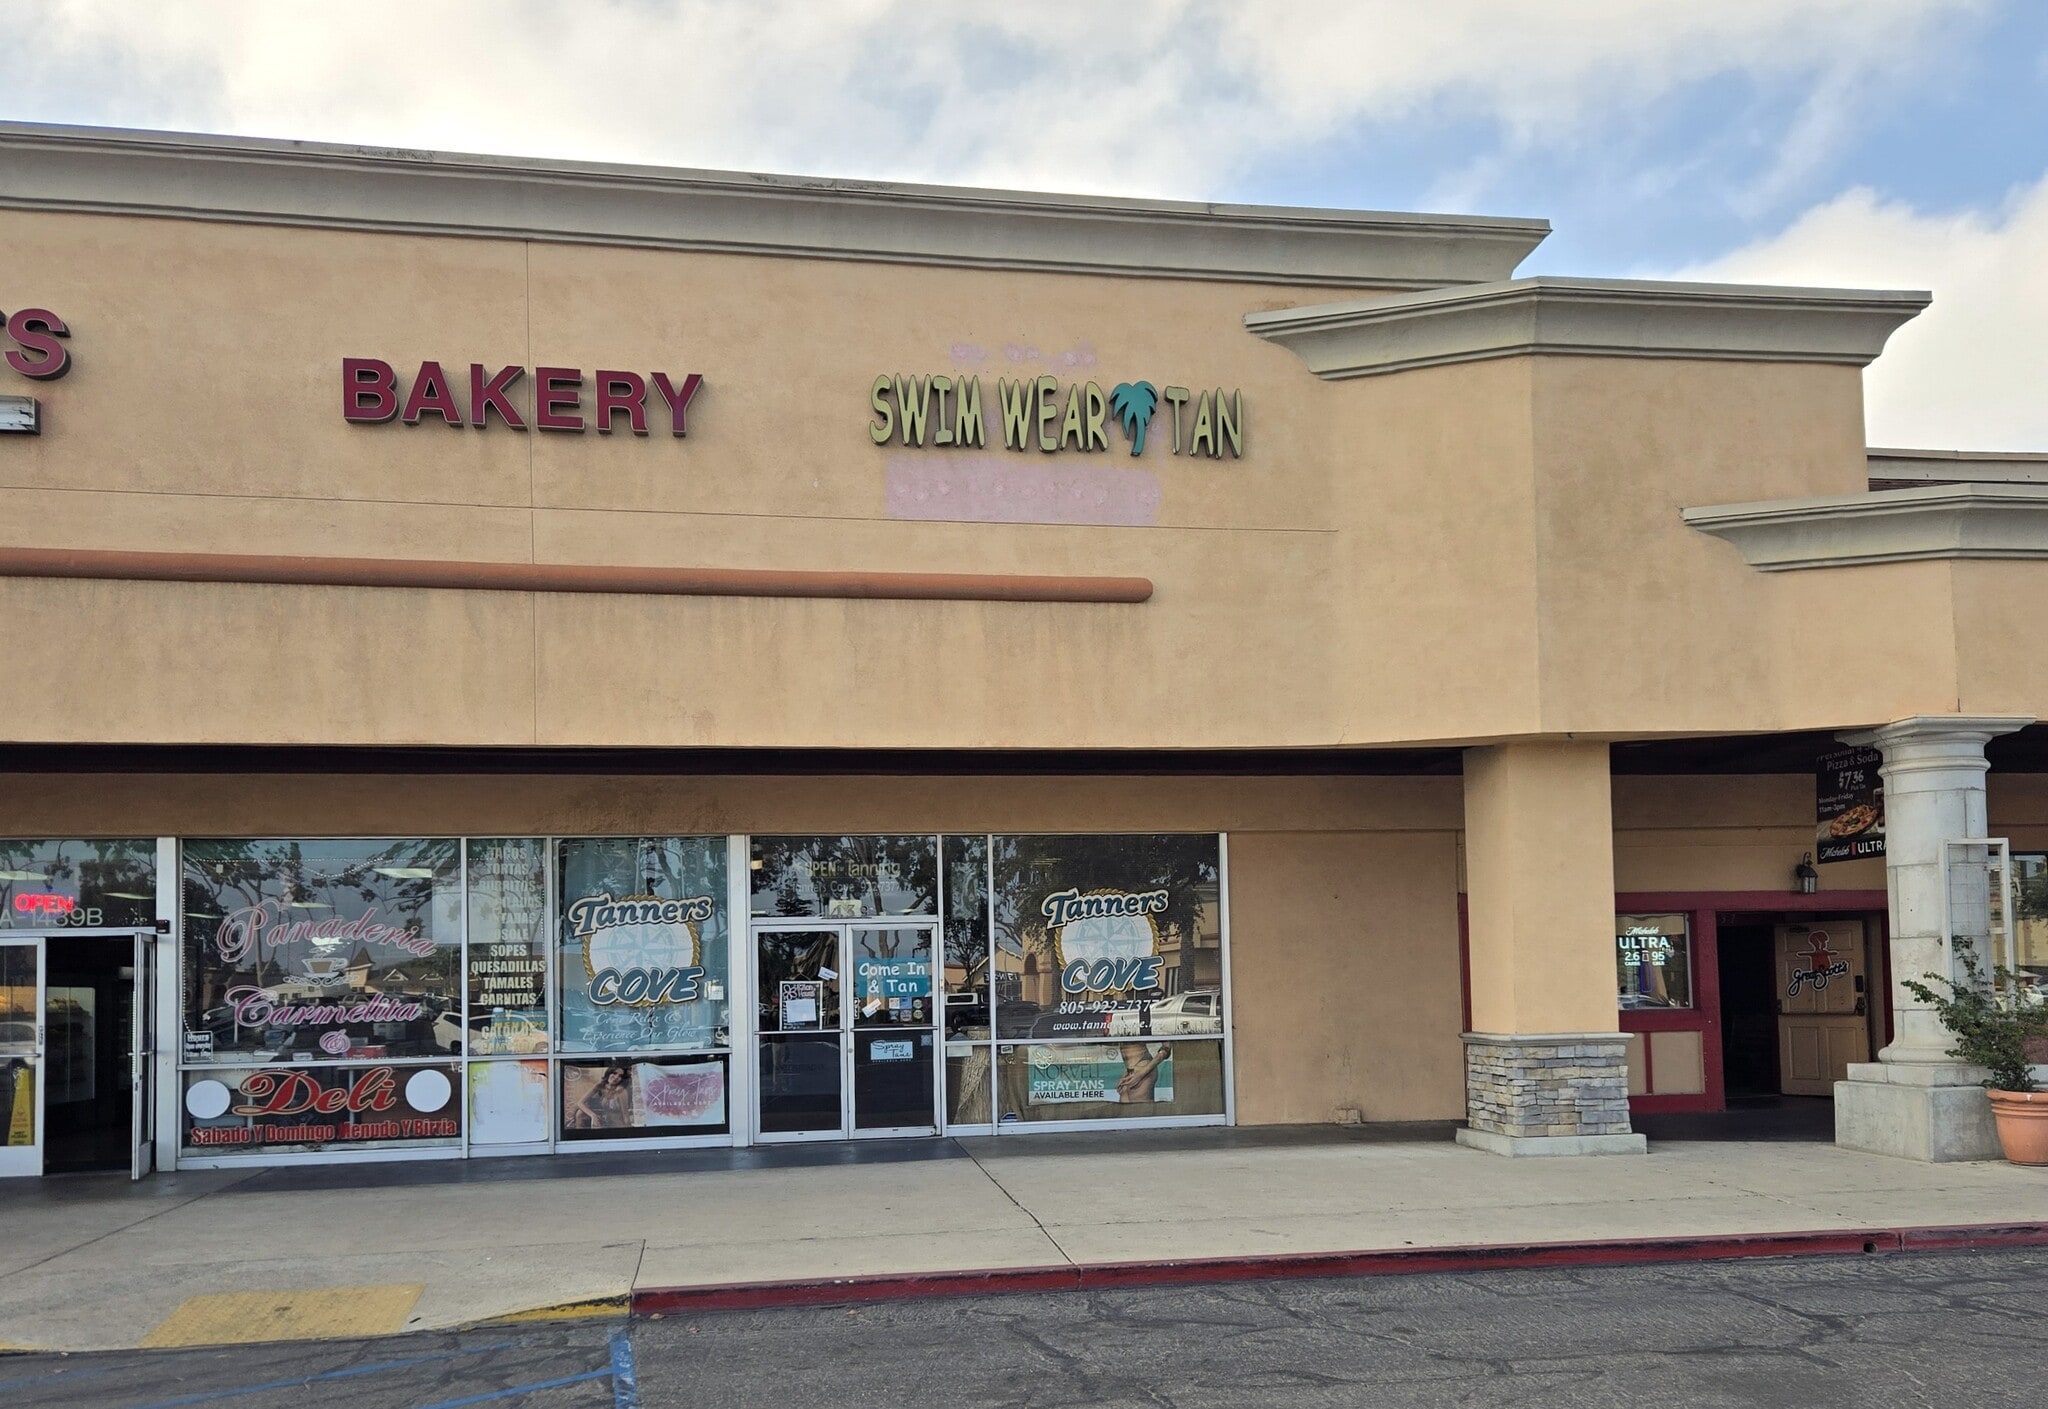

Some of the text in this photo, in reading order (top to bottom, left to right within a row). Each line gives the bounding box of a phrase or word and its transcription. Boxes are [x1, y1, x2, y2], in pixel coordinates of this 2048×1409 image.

[342, 357, 704, 437] BAKERY
[869, 372, 1243, 459] SWIM WEAR TAN
[1827, 759, 1849, 772] Pizza
[1857, 751, 1879, 764] Soda
[805, 860, 837, 877] OPEN
[847, 860, 901, 877] Tanning
[14, 893, 74, 913] OPEN
[1041, 887, 1169, 930] Tanners
[568, 892, 713, 937] Tanners
[217, 900, 437, 963] Panaderia
[1625, 926, 1660, 936] Michelob
[490, 944, 527, 957] SOPES
[1618, 936, 1670, 949] ULTRA
[1651, 951, 1666, 961] 95
[470, 960, 546, 975] QUESADILLAS
[858, 961, 926, 977] Come In
[1061, 956, 1165, 994] COVE
[482, 976, 534, 989] TAMALES
[589, 966, 705, 1005] COVE
[868, 979, 919, 993] & Tan
[224, 985, 423, 1027] Carmelita
[480, 993, 537, 1006] CARNITAS
[871, 1039, 905, 1055] Spray
[232, 1066, 397, 1117] Deli
[1033, 1079, 1105, 1091] SPRAY TANS
[1034, 1090, 1105, 1099] AVAILABLE HERE
[191, 1115, 457, 1145] Sabado Y Domingo Menudo Y Birria
